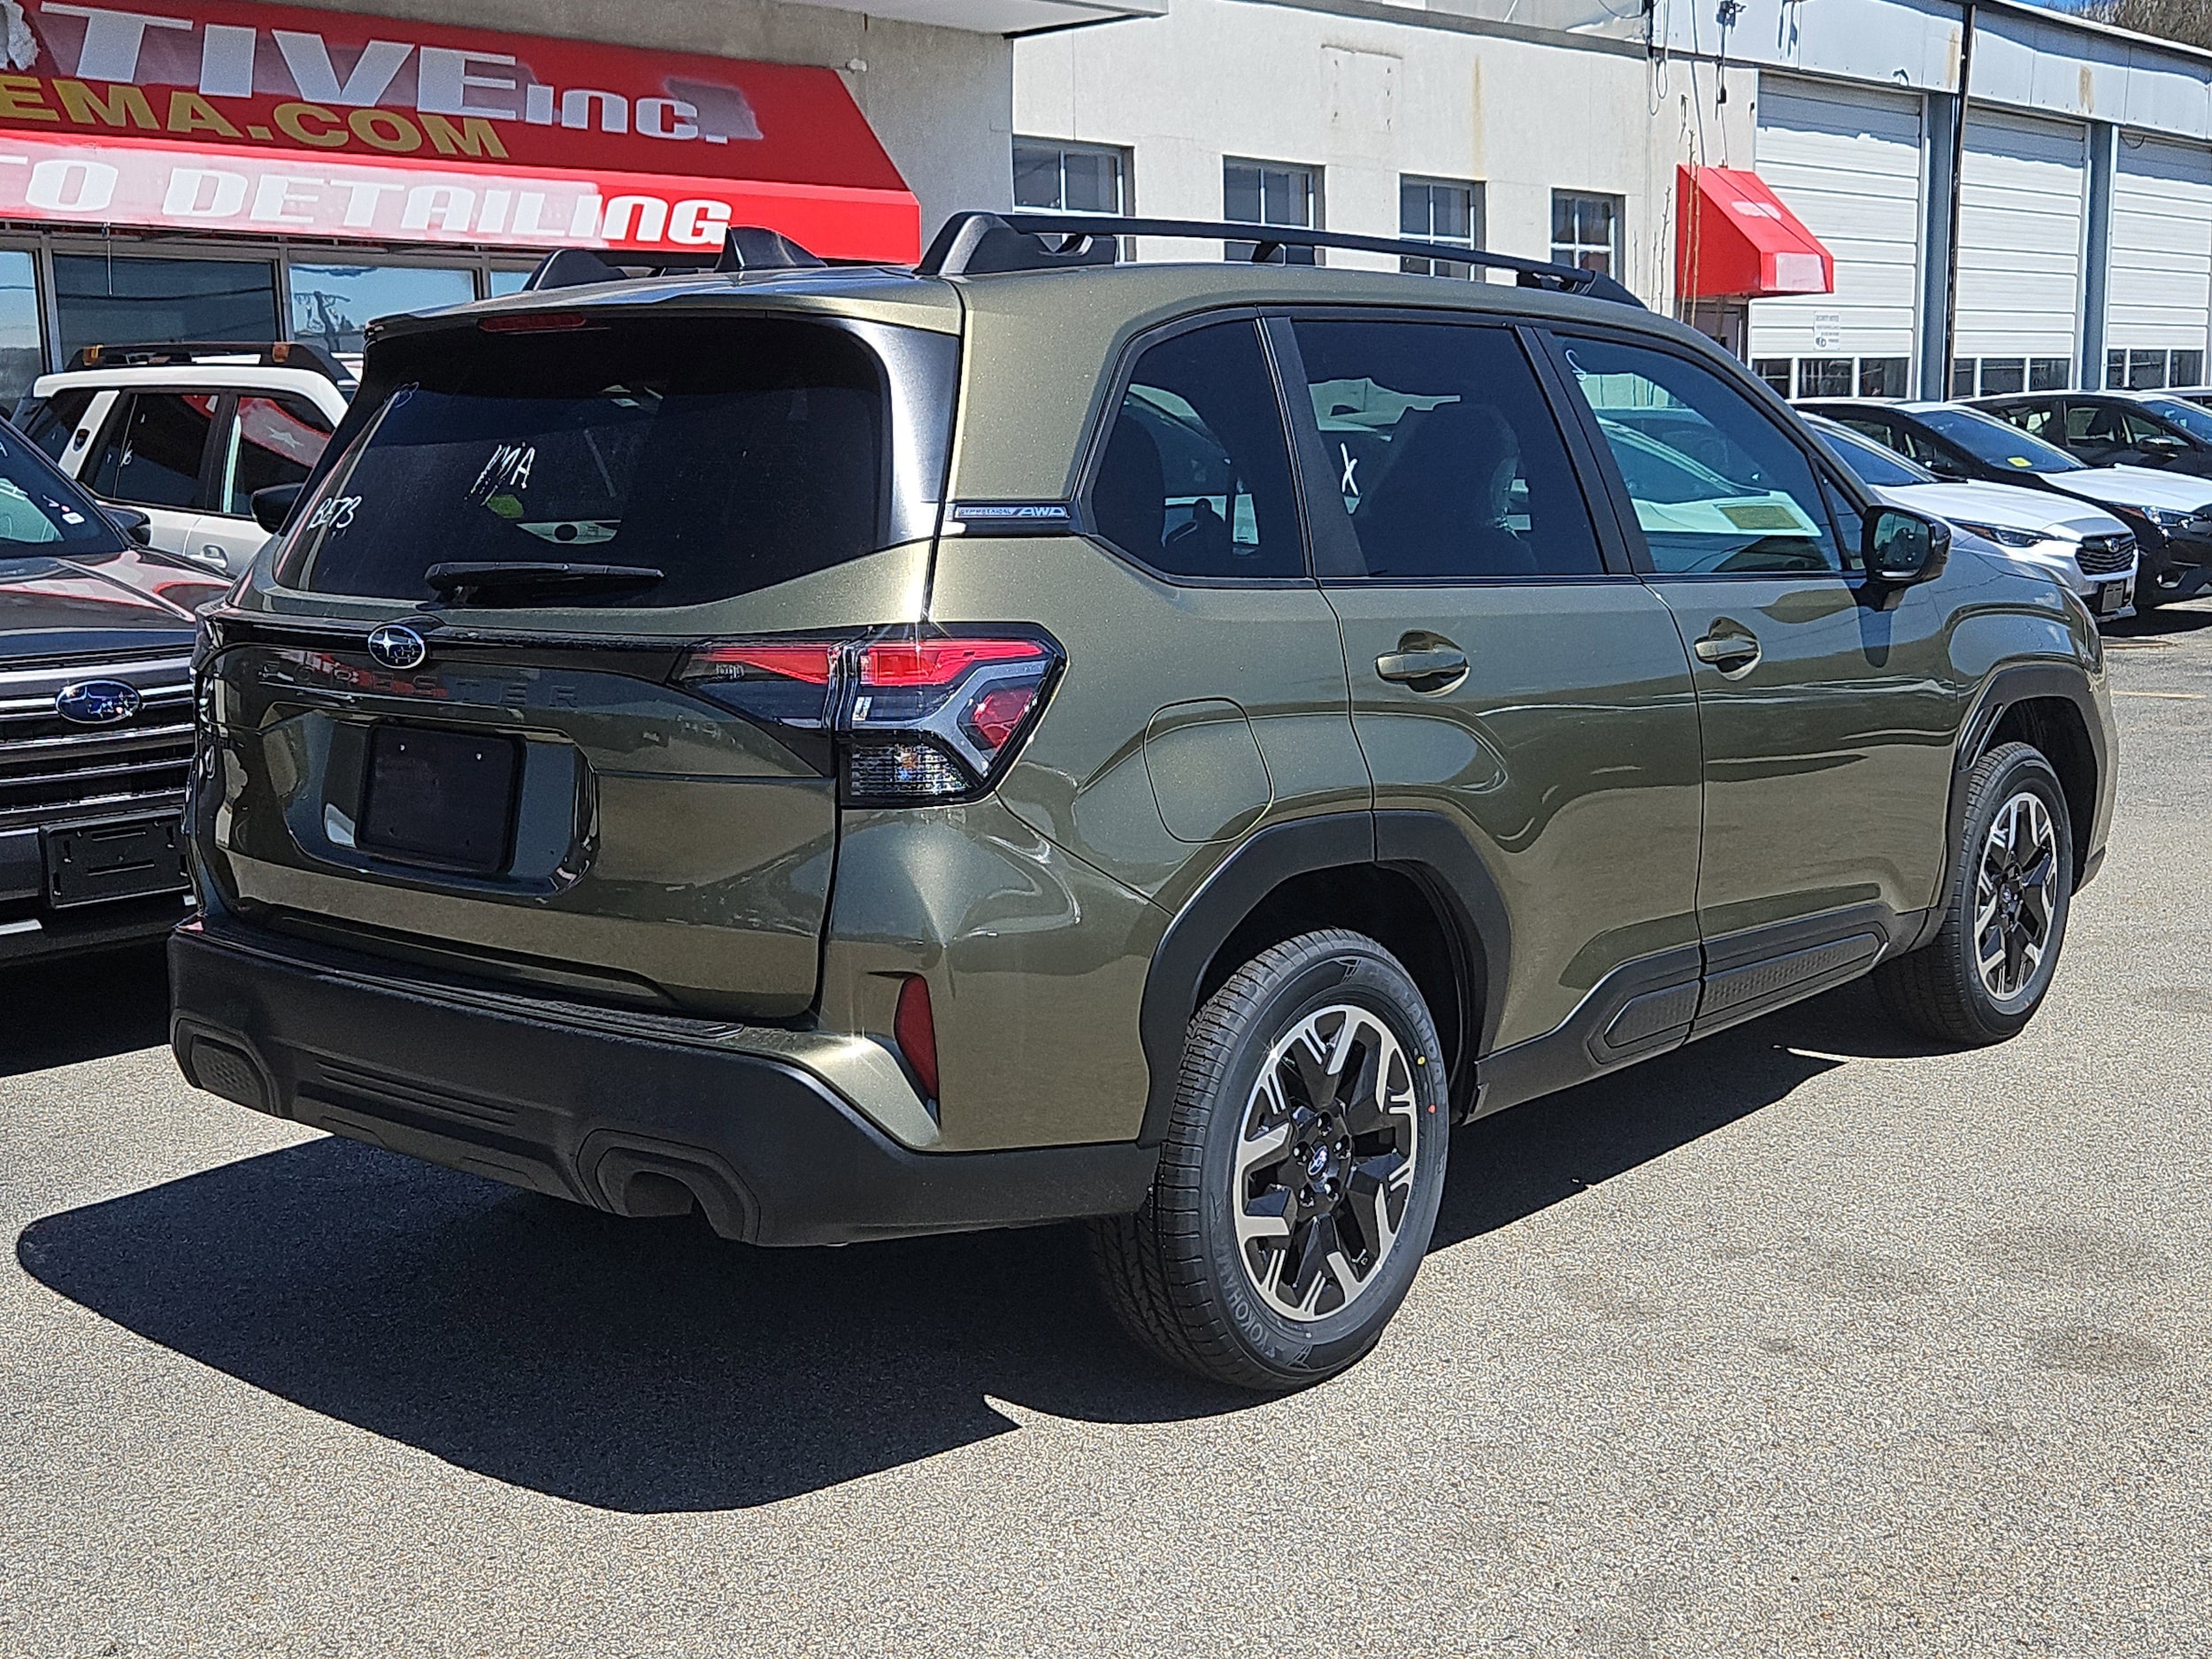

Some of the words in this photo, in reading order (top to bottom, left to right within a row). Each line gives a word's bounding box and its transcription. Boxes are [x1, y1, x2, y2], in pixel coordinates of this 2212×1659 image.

[0, 74, 510, 157] EMA.COM
[162, 166, 733, 245] DETAILING
[1017, 506, 1066, 517] AWD
[259, 661, 578, 708] FORESTER
